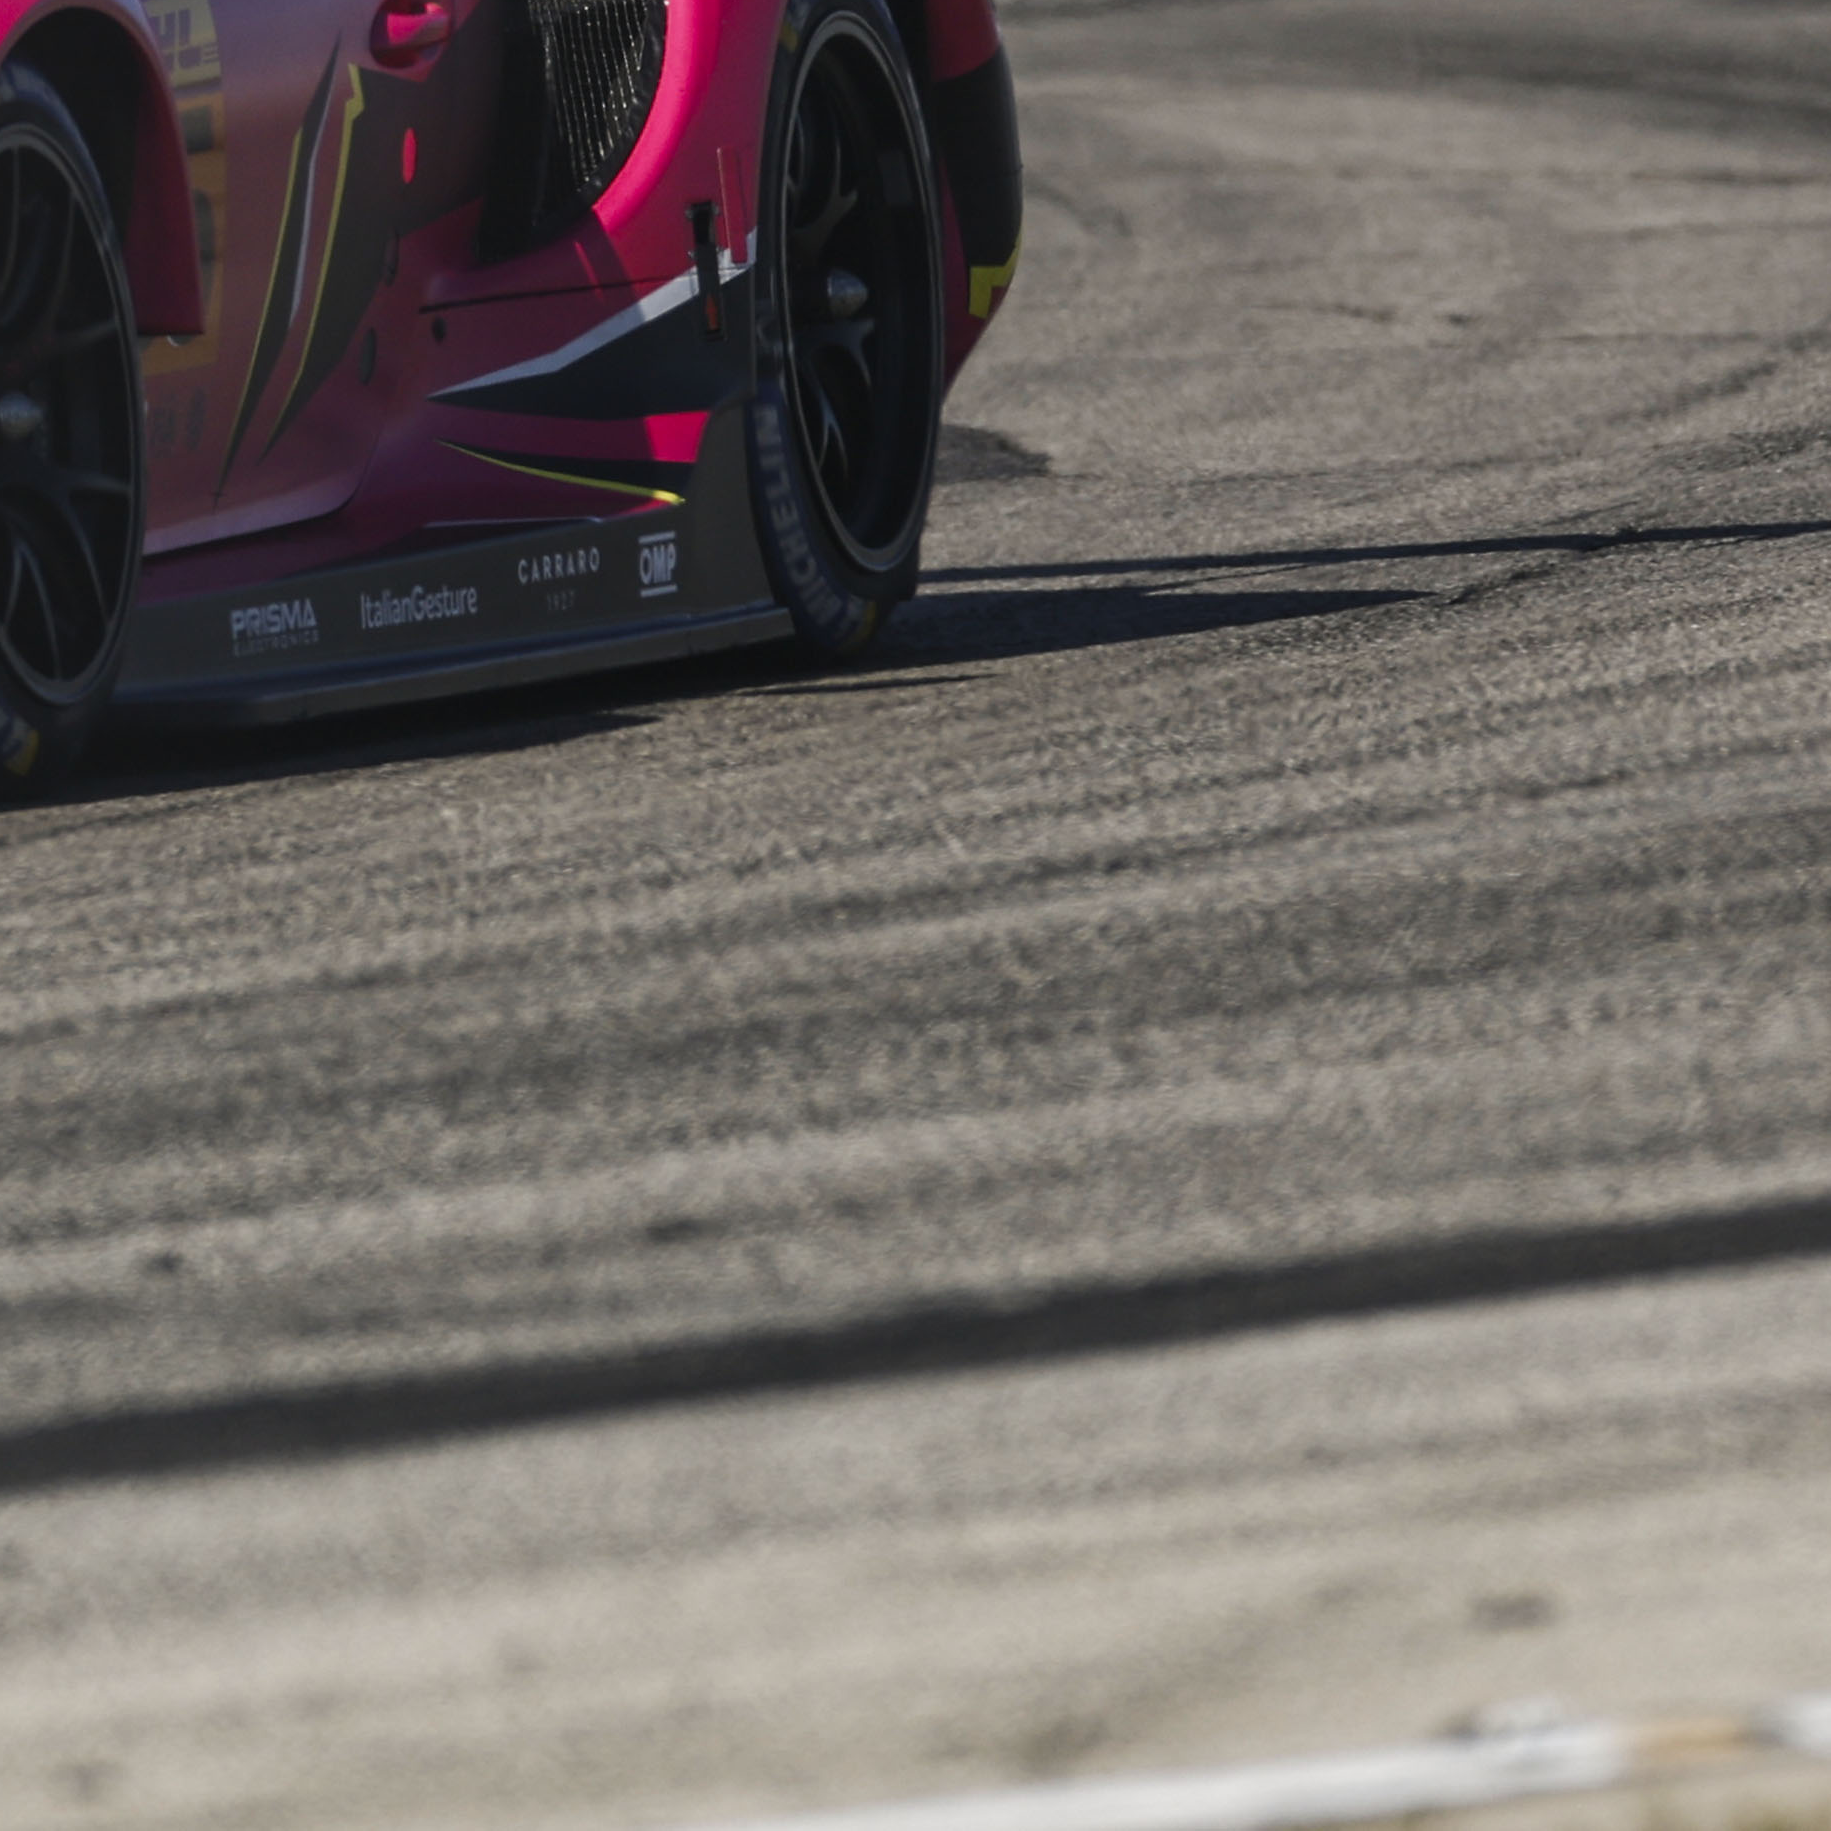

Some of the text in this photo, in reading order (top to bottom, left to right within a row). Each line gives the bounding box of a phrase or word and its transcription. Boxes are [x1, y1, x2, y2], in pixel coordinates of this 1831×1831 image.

[517, 546, 601, 584] CARRARO
[639, 545, 677, 585] OMP
[230, 598, 317, 639] PRISMA
[360, 584, 478, 630] ItalianGesture
